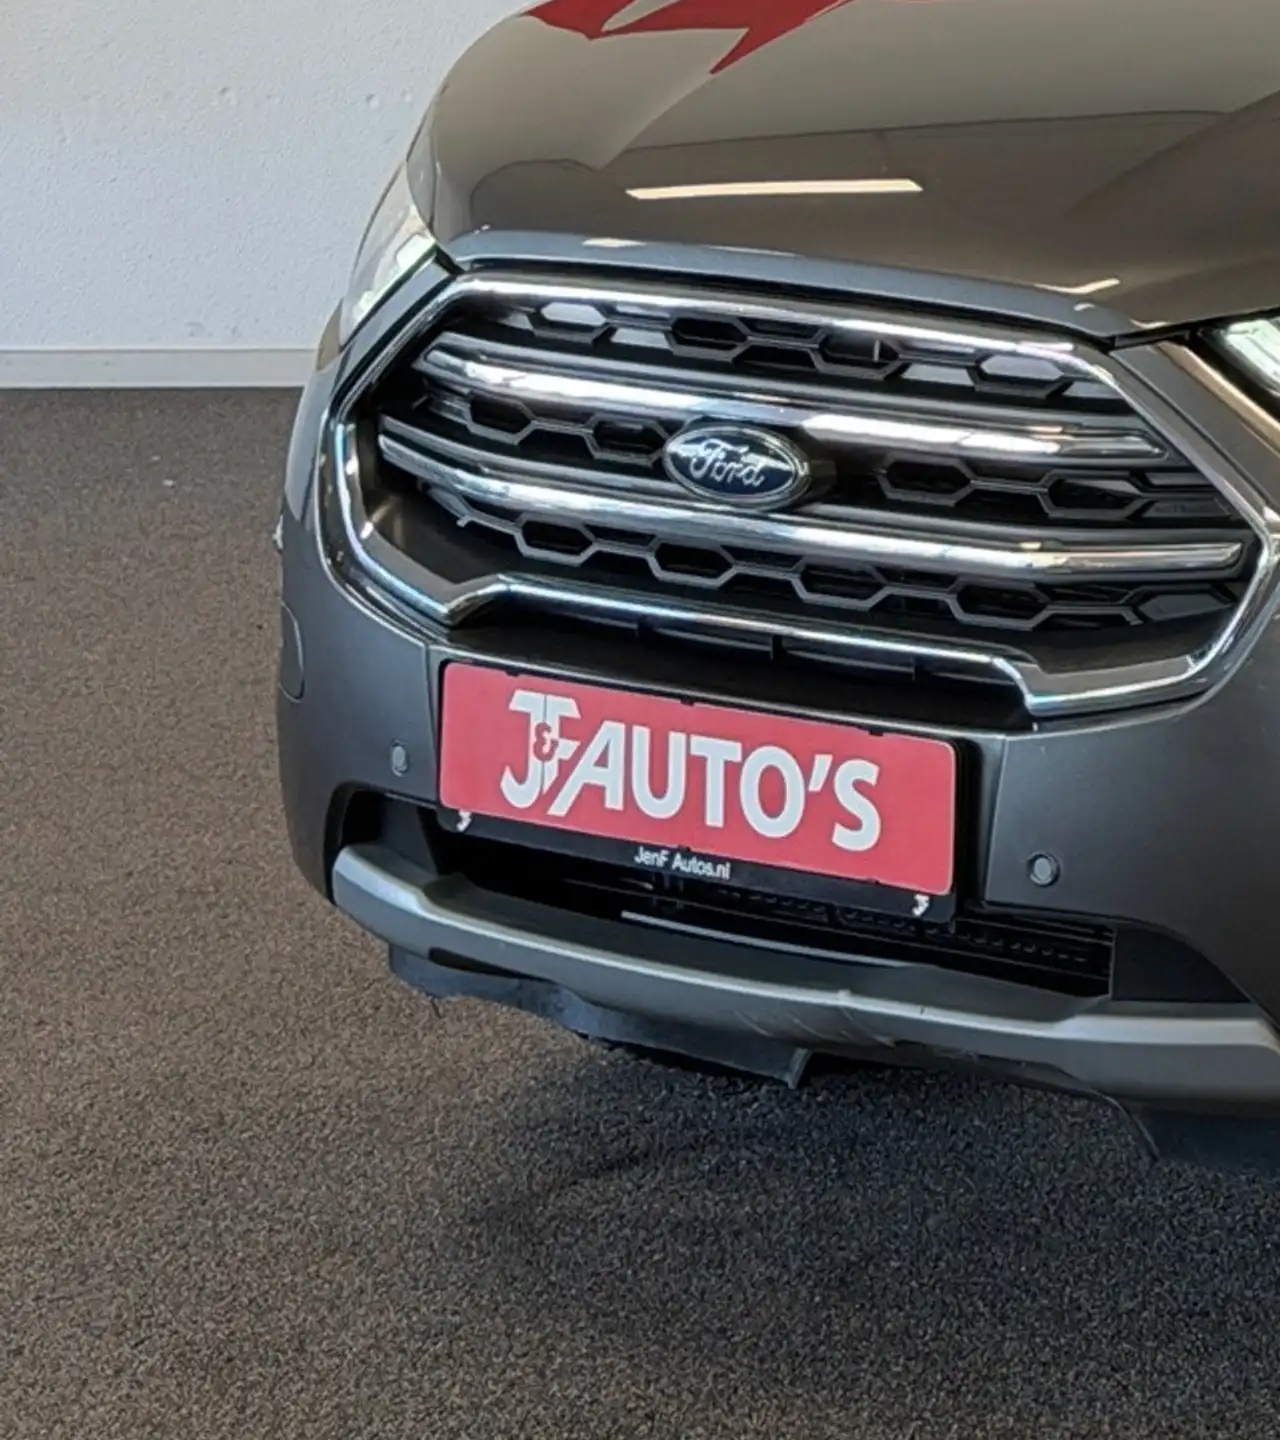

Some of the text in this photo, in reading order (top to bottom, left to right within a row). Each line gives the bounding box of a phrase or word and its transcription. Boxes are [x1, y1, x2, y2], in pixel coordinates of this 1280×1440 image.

[690, 438, 766, 487] Ford
[634, 846, 731, 880] JenF Autos.nl
